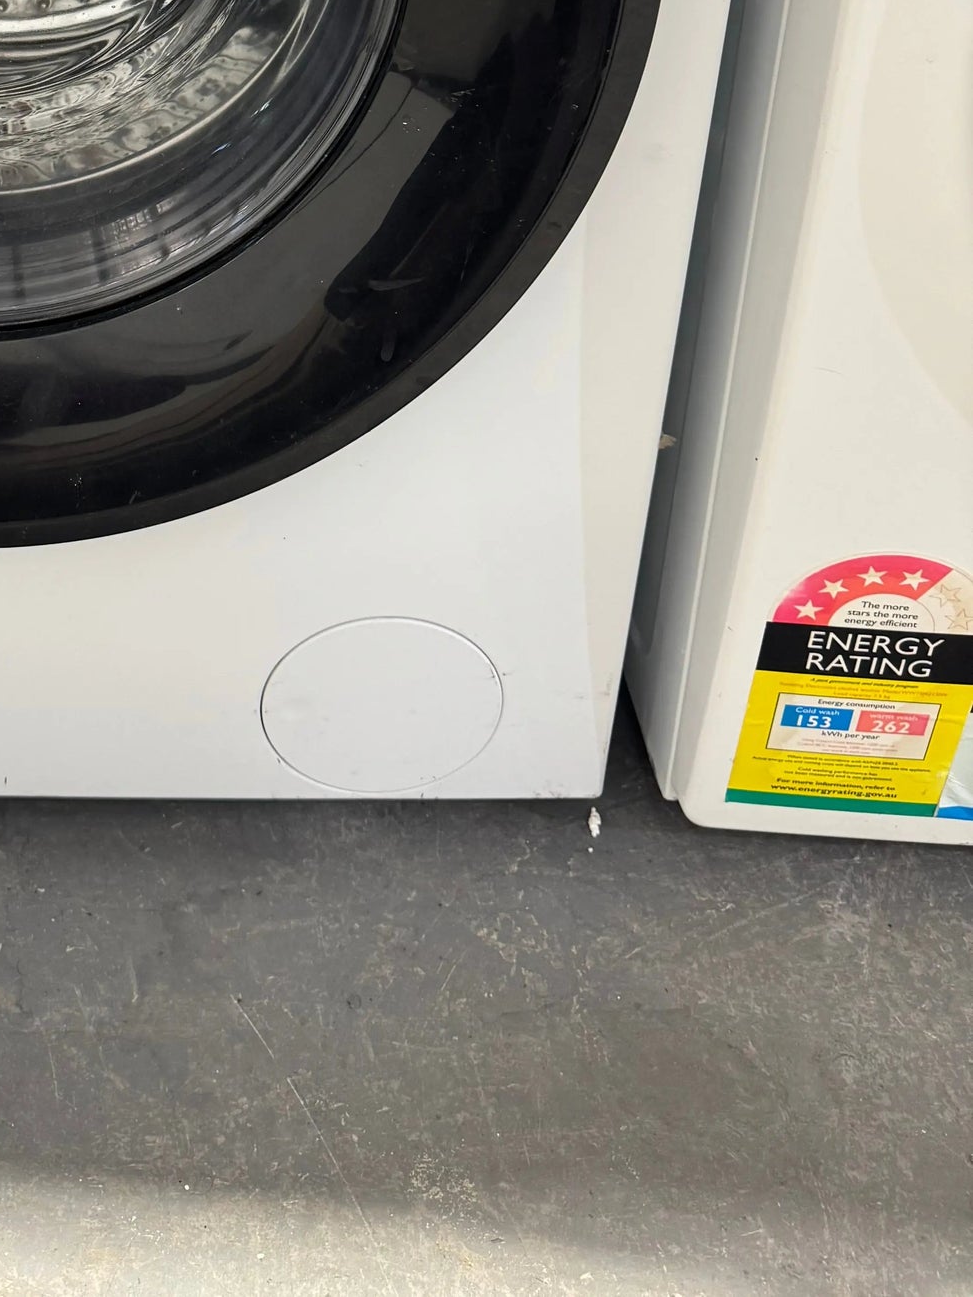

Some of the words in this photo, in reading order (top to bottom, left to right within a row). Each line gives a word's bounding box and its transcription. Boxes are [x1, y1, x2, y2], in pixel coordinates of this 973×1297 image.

[862, 601, 880, 609] The
[845, 618, 877, 626] energy
[807, 631, 945, 656] ENERGY
[805, 653, 932, 677] RATING
[818, 699, 844, 707] Energy
[796, 715, 832, 728] 153
[872, 720, 910, 733] 262
[771, 784, 897, 798] www.energyrating.gov.au
